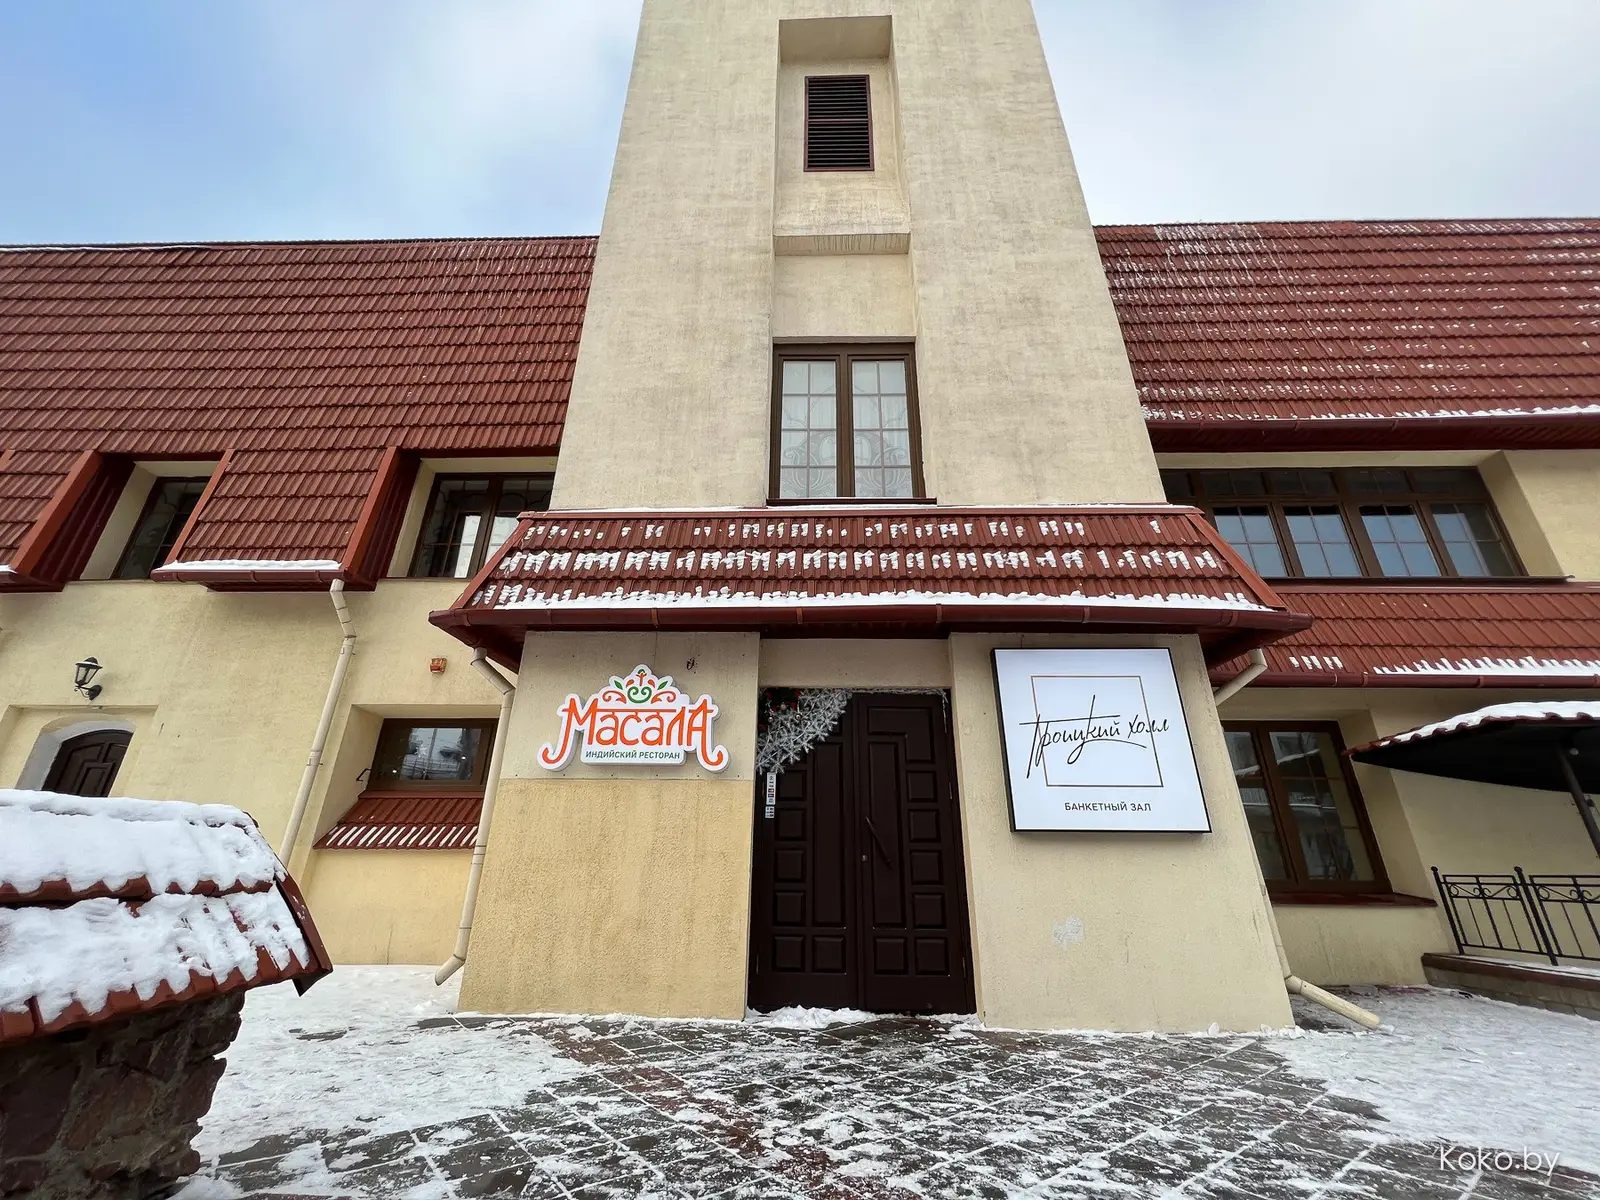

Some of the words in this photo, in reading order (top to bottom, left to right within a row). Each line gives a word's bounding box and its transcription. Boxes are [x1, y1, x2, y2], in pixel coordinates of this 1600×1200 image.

[1019, 694, 1147, 779] Троицкий
[585, 750, 637, 759] ИНДИЙСКИЙ
[638, 751, 681, 760] РЕСТОРАН
[1064, 801, 1128, 812] БАНКЕТНЫЙ
[1130, 802, 1152, 812] ЗАЛ
